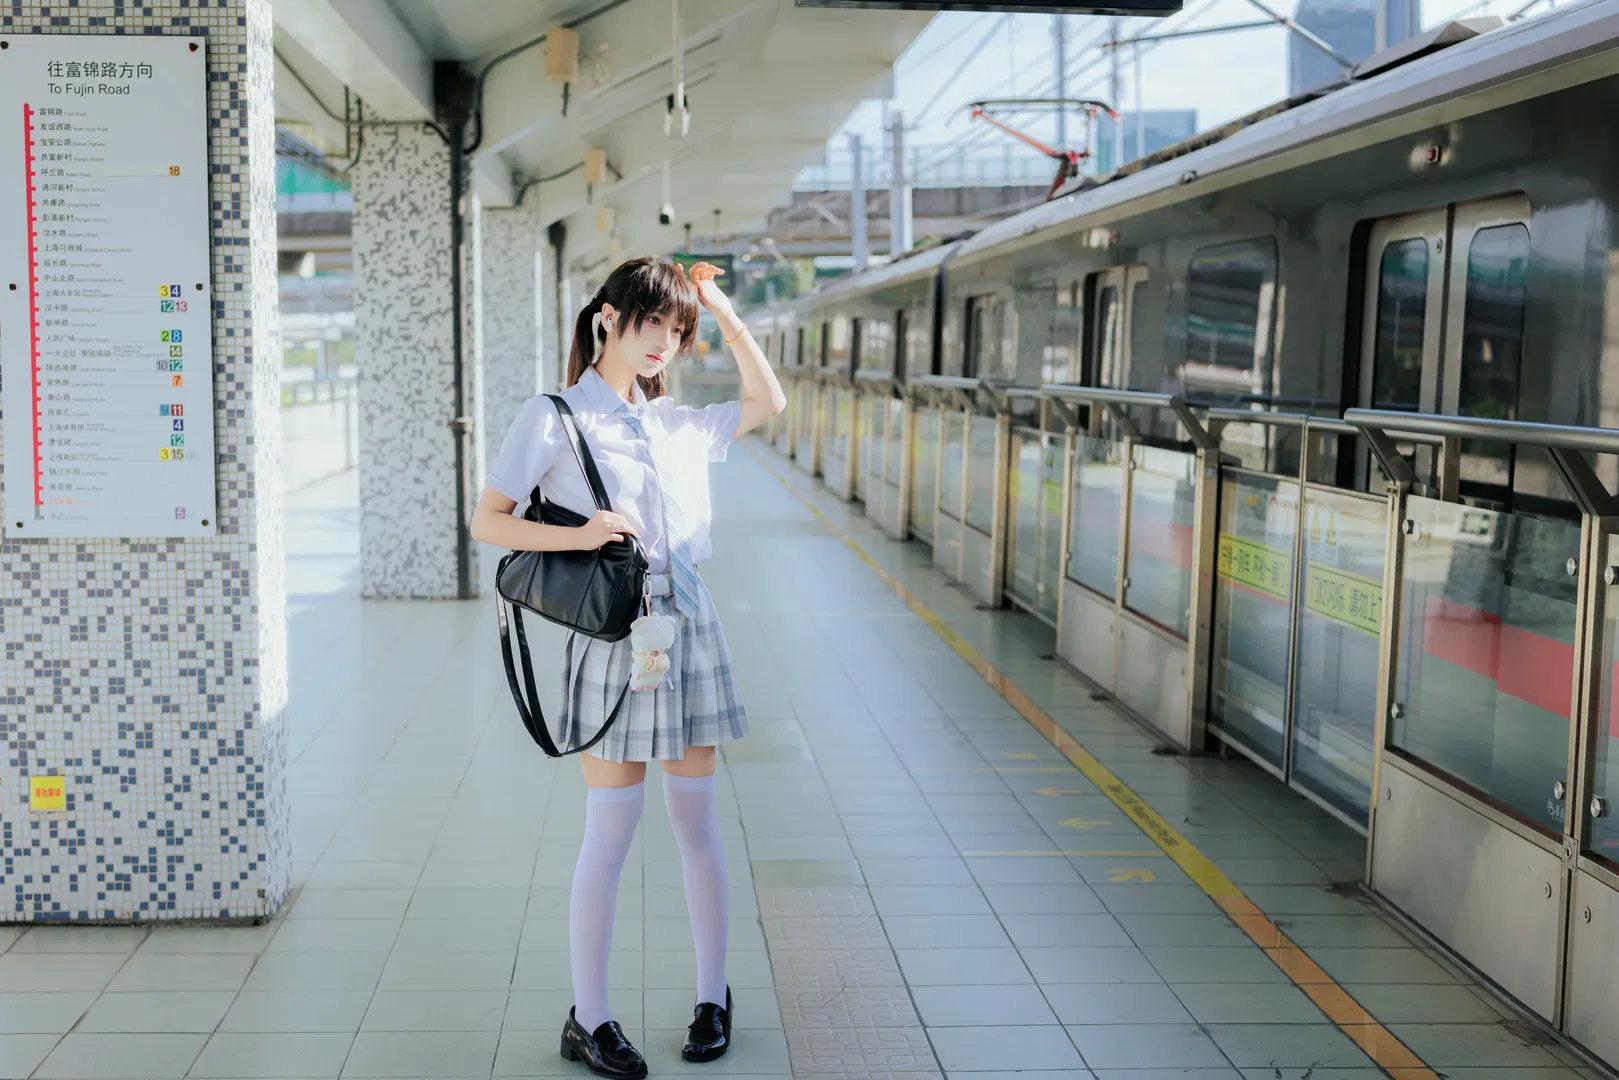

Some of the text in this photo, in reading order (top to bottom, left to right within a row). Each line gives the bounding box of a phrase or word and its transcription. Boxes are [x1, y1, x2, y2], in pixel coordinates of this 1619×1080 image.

[47, 61, 153, 79] 往富锦路方向
[47, 83, 130, 97] To Fujin Road
[39, 108, 63, 116] 富锦路
[40, 123, 72, 131] 友谊西路
[40, 138, 72, 146] 宝安公路
[41, 153, 72, 161] 共富新村
[40, 168, 64, 176] 呼兰路
[168, 166, 181, 176] 18
[42, 183, 73, 192] 通河新村
[42, 199, 66, 207] 共康路
[44, 244, 83, 252] 上海马戏城
[44, 274, 75, 282] 中山北路
[44, 289, 81, 297] 上海火车站
[160, 285, 180, 296] 3 4
[161, 301, 188, 312] 12 13
[162, 330, 181, 342] 2 8
[170, 346, 182, 357] 14
[157, 360, 182, 371] 10 12
[161, 405, 182, 416] 9 11
[174, 420, 182, 431] 4
[171, 434, 184, 445] 12
[161, 449, 169, 460] 3
[172, 449, 184, 460] 15
[176, 508, 184, 519] 5
[1349, 588, 1383, 623] 请勿上
